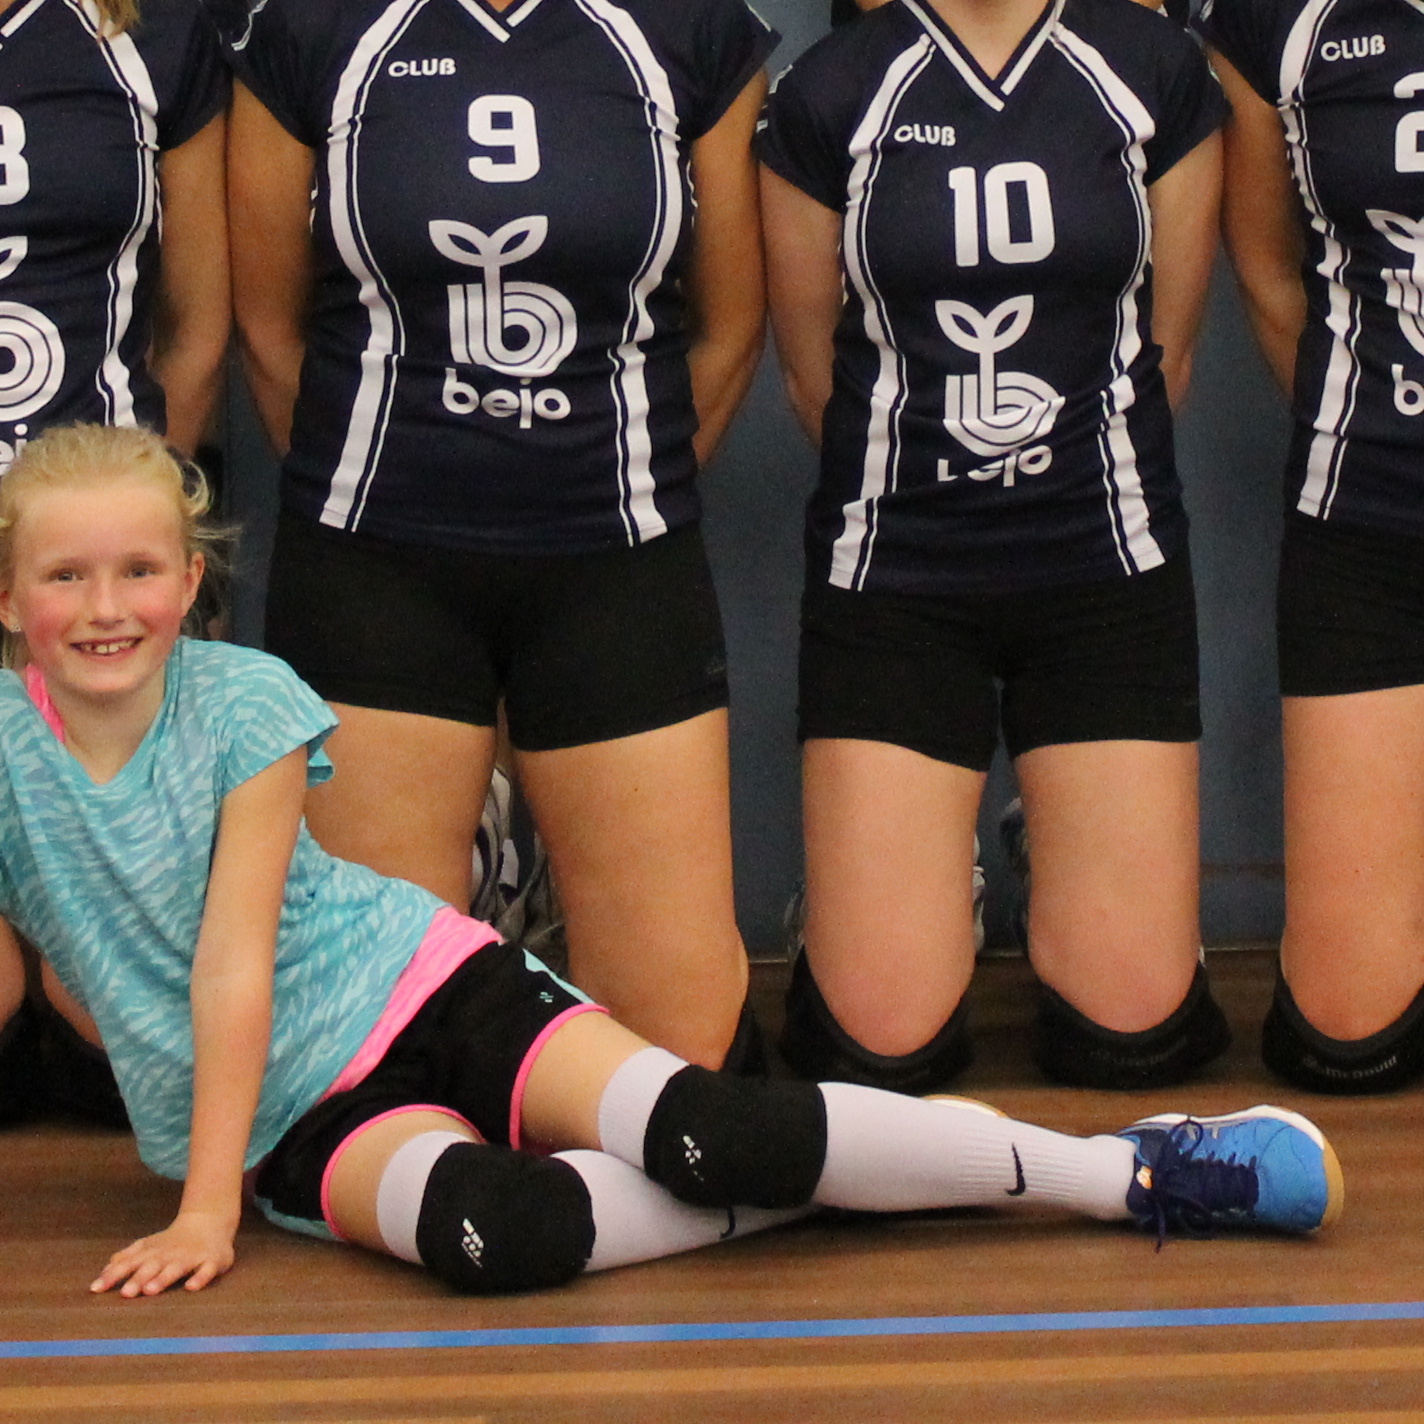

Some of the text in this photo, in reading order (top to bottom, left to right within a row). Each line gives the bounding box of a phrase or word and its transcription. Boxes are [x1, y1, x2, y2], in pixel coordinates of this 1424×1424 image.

[388, 57, 456, 78] CLUB
[1320, 33, 1386, 62] CLUB
[467, 94, 541, 183] 9
[894, 124, 956, 147] CLUB
[948, 161, 1055, 267] 10
[442, 368, 572, 429] bejo
